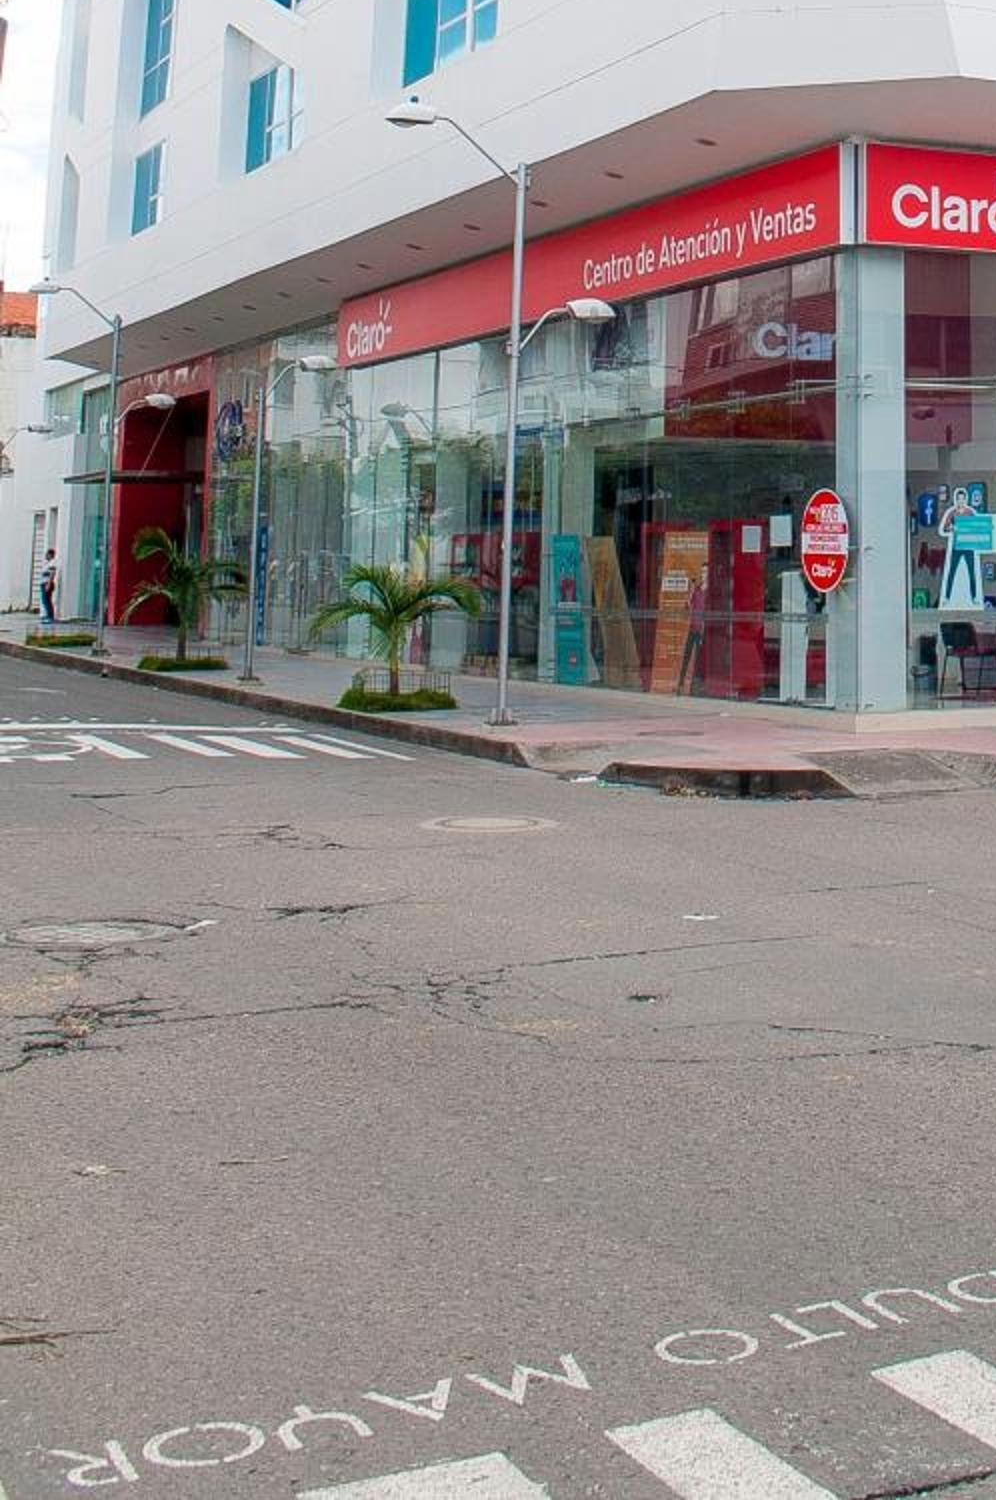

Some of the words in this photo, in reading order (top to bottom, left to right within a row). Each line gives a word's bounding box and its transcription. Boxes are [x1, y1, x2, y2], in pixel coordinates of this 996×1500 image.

[583, 257, 633, 290] Centro
[635, 243, 655, 274] de
[659, 218, 731, 269] Atención
[735, 221, 747, 259] y
[749, 202, 817, 245] Ventas
[346, 316, 386, 358] Claro
[811, 563, 834, 578] Claro
[47, 1352, 593, 1488] MAYOR
